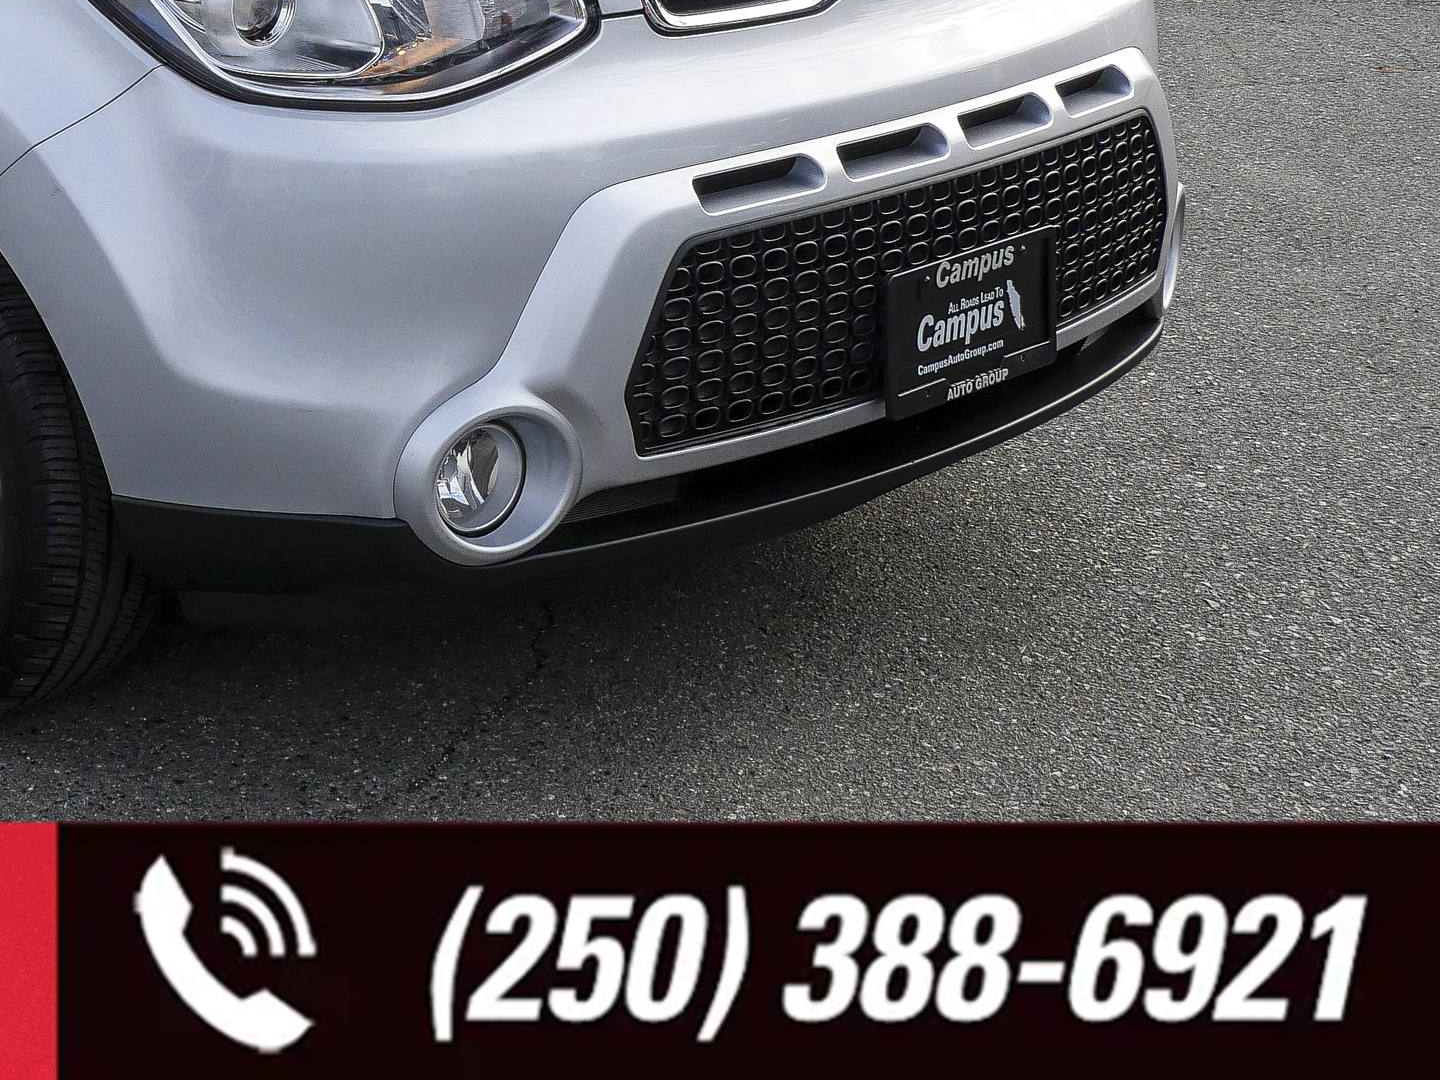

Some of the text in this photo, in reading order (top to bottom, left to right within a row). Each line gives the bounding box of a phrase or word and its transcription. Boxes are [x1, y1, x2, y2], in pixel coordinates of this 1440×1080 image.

[936, 245, 1015, 289] Campus
[917, 300, 1005, 352] Campus
[918, 339, 1004, 376] CampusAutoGroup.com
[947, 368, 1009, 401] AUTO GROUP
